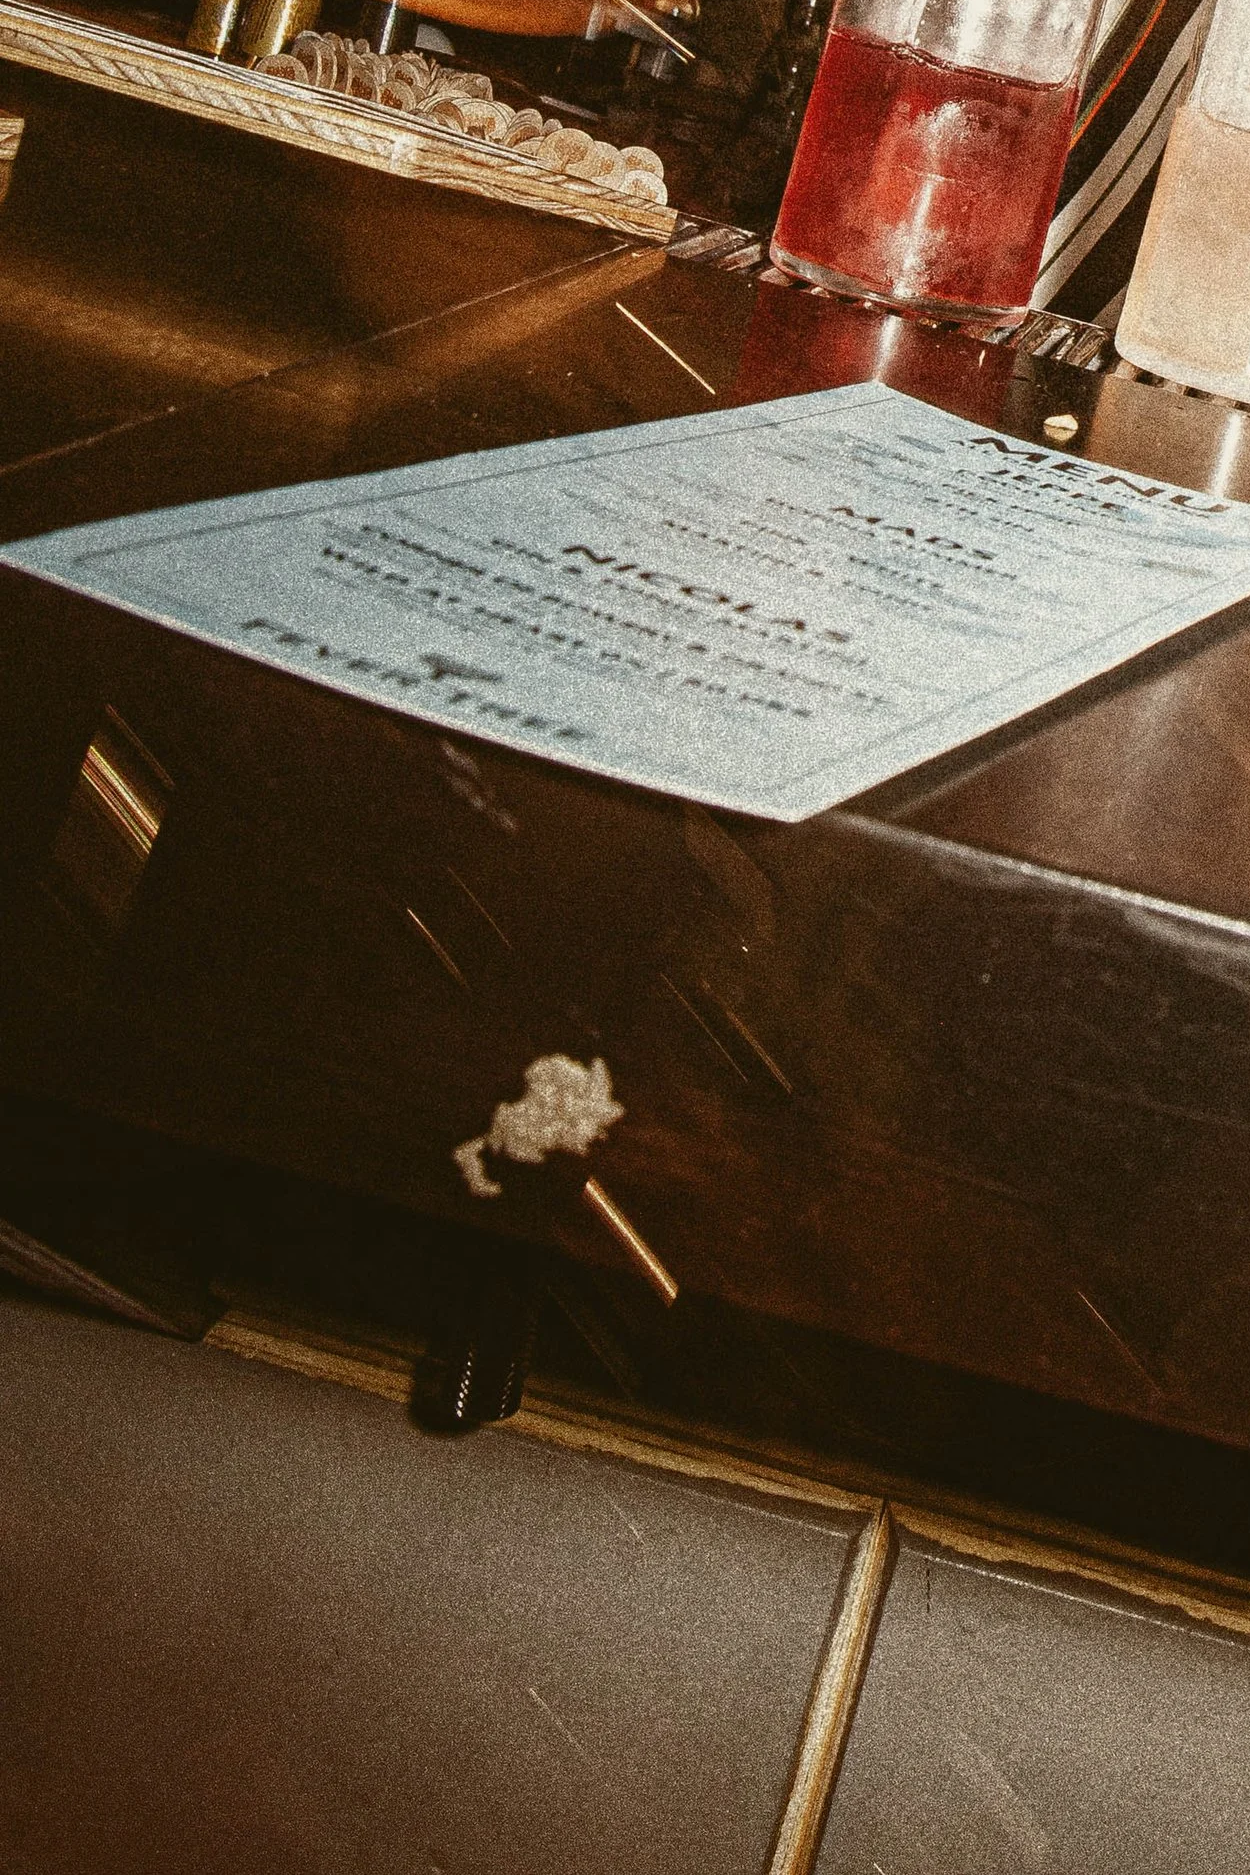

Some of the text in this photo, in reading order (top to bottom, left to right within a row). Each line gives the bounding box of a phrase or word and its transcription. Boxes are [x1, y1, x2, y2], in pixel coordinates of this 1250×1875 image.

[970, 436, 1232, 513] MENU
[989, 468, 1125, 511] JEPPE
[830, 506, 999, 559] MADS
[558, 545, 854, 645] NICOLAS
